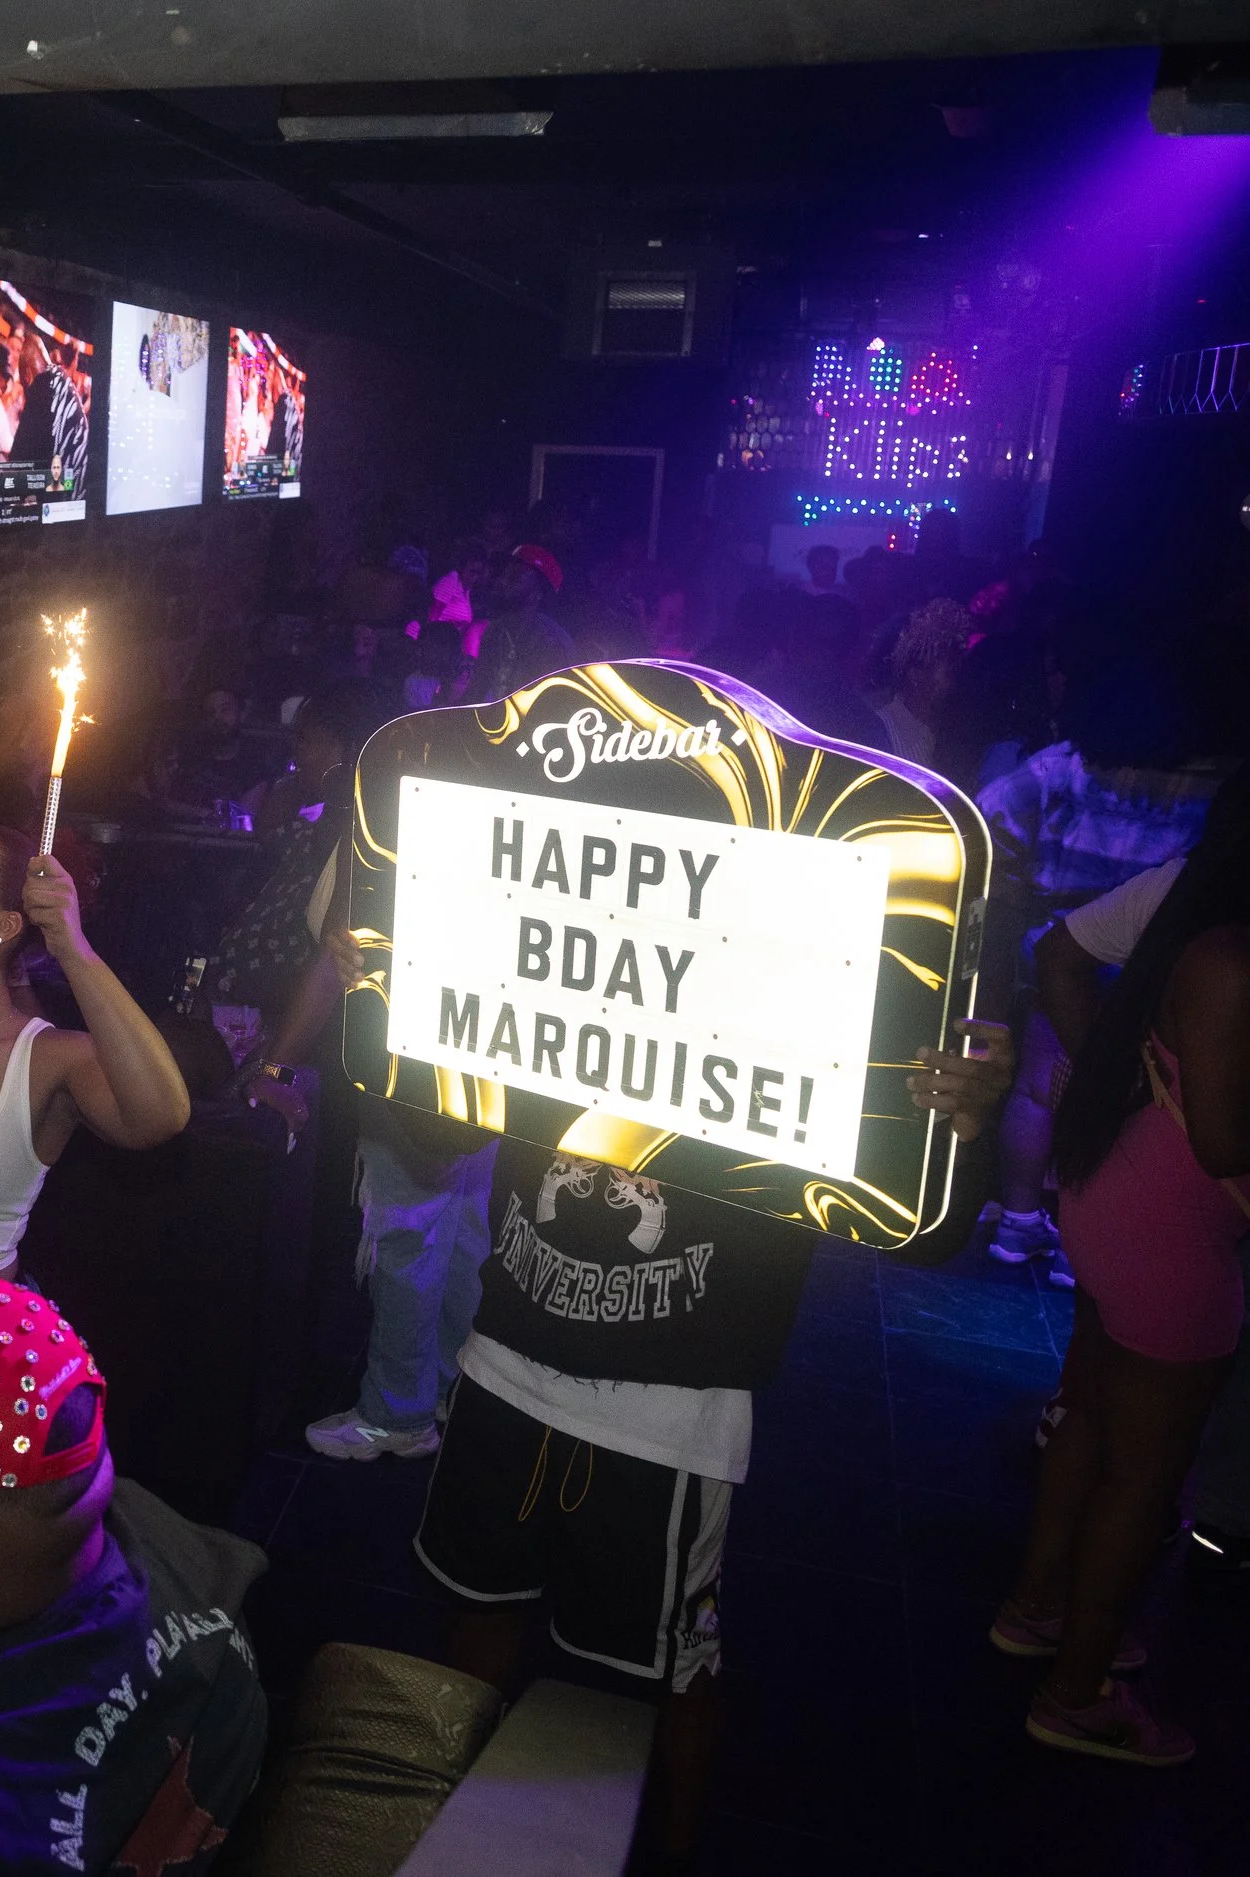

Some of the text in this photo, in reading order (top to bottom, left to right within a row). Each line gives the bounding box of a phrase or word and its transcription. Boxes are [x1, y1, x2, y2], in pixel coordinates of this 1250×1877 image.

[531, 707, 723, 783] Sidebar
[490, 816, 720, 920] HAPPY
[516, 915, 696, 1014] BDAY
[438, 986, 815, 1144] MARQUISE!
[50, 1783, 89, 1872] ALL
[74, 1673, 149, 1767] DAY.
